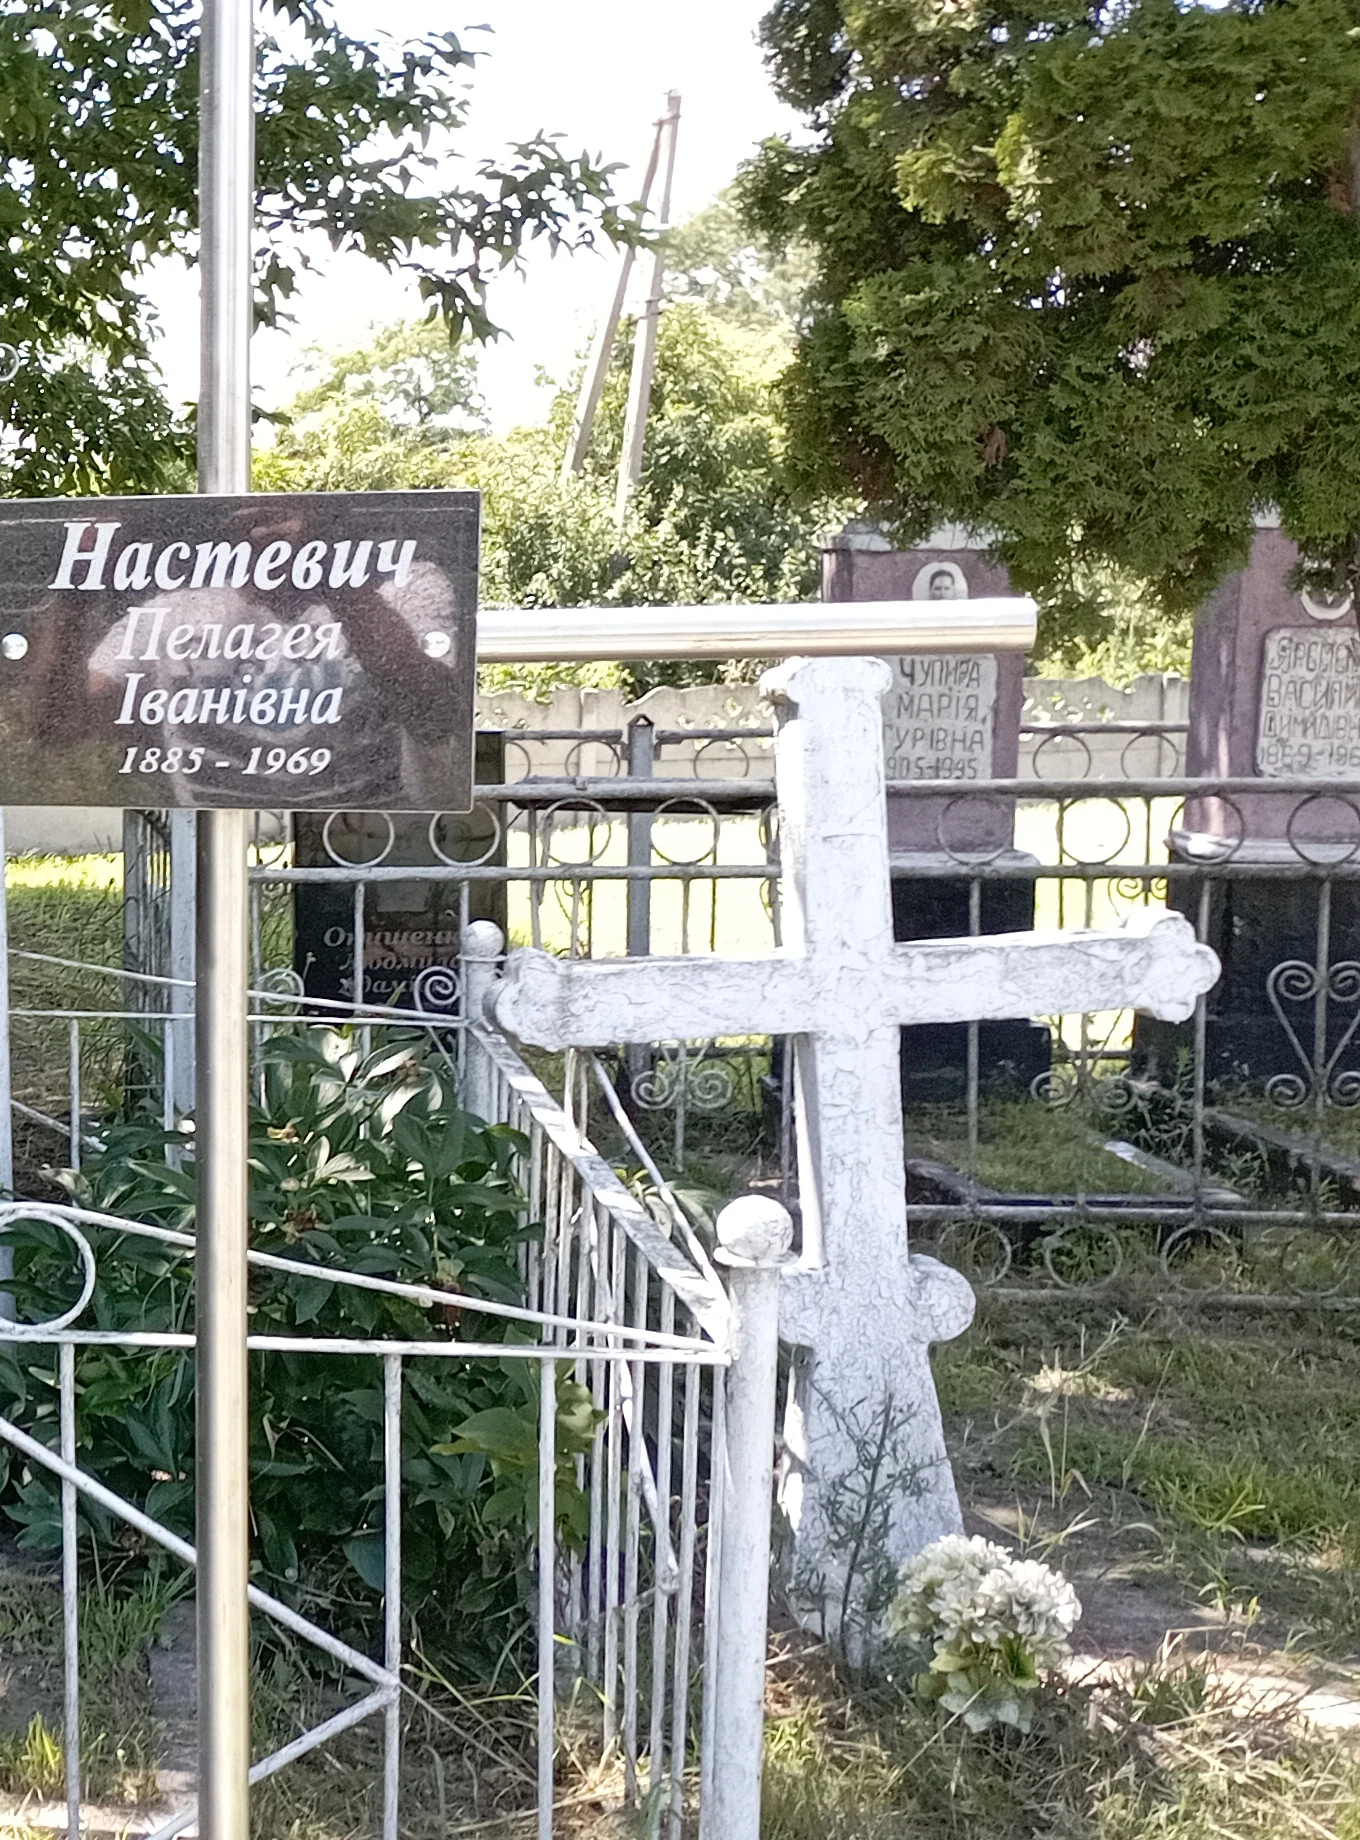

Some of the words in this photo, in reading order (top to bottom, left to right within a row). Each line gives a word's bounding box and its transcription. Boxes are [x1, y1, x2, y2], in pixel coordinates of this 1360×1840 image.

[48, 521, 418, 592] Настевич
[115, 606, 343, 662] Пелагея
[114, 672, 343, 726] Іванівна
[118, 746, 205, 775] 1885
[215, 760, 229, 768] -
[241, 746, 331, 775] 1969
